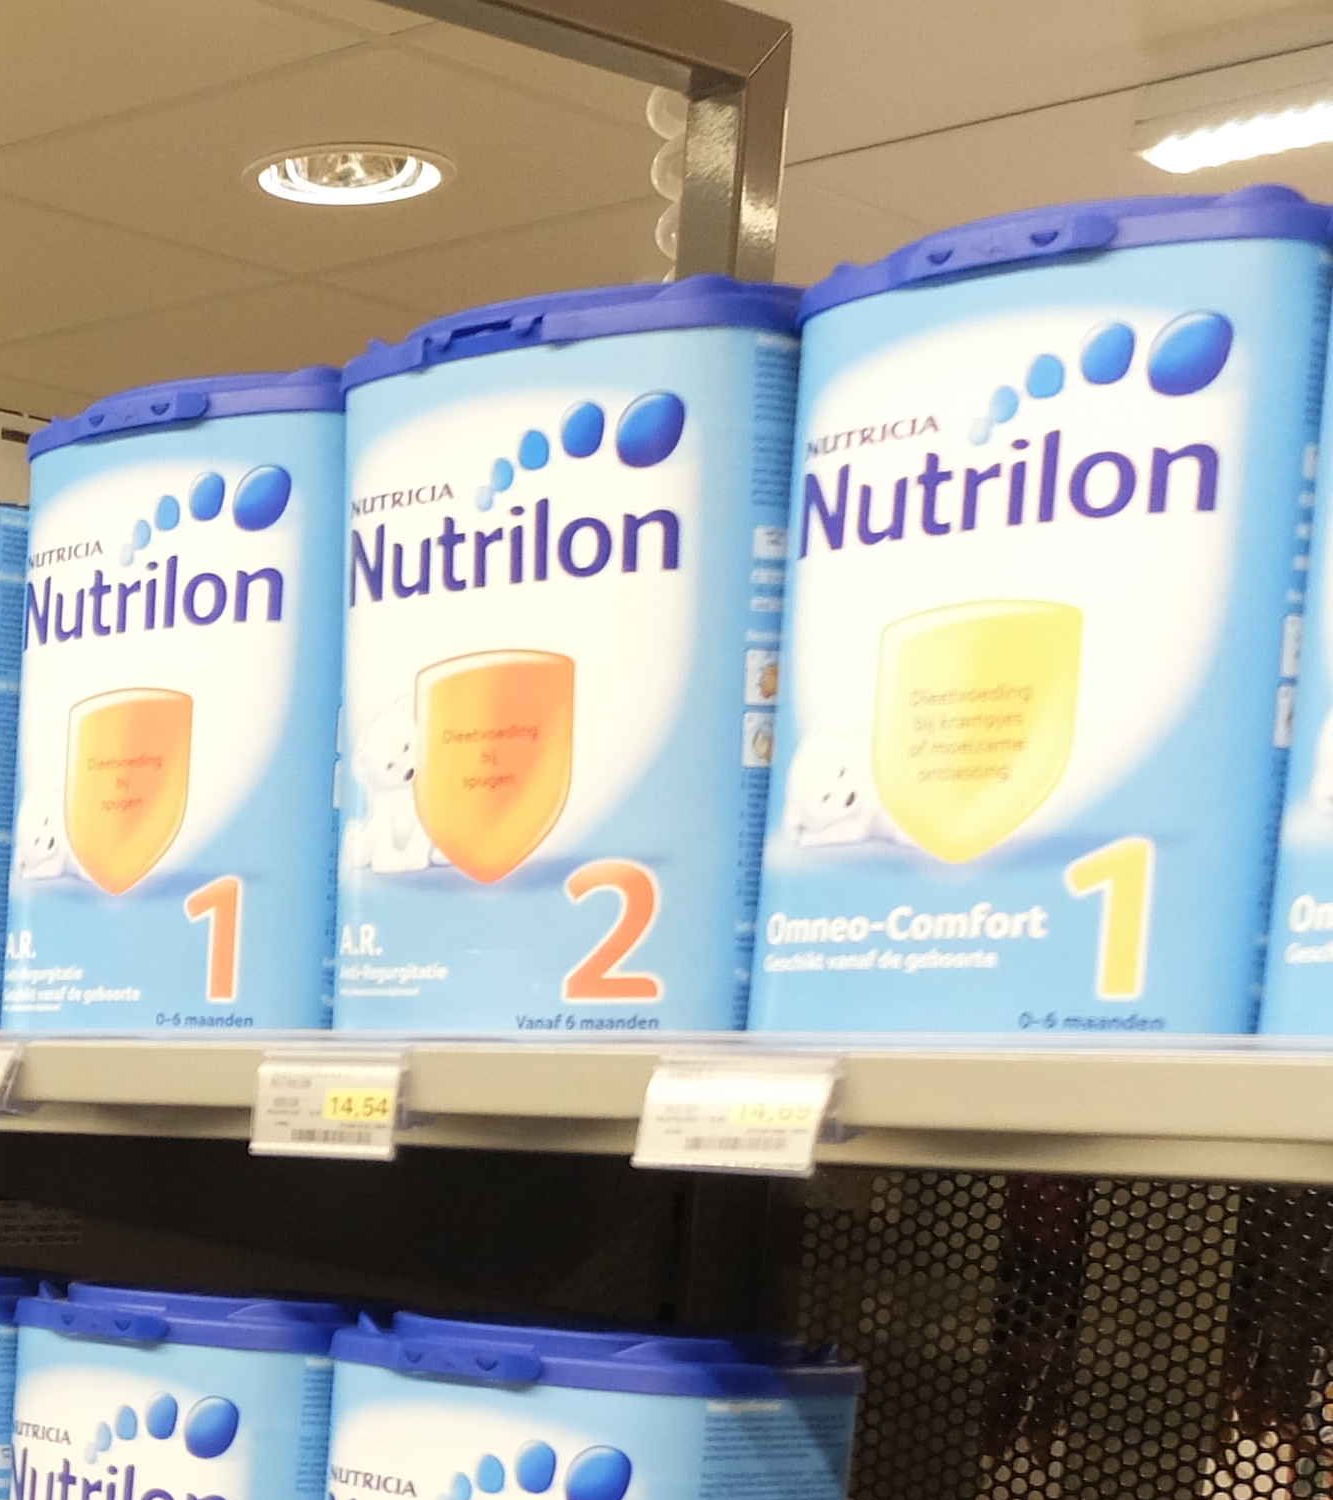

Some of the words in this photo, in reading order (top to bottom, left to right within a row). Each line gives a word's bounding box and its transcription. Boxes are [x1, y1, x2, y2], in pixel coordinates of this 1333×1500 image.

[798, 430, 1219, 559] Nutrilon
[349, 497, 680, 608] Nutrilon
[24, 555, 284, 649] Nutrilon
[184, 874, 243, 1004] 1
[340, 924, 383, 956] A.R.
[562, 858, 664, 1004] 2
[767, 903, 1048, 945] Omneo-Comfort
[1063, 836, 1155, 1001] 1
[184, 1013, 253, 1027] maanden
[515, 1014, 562, 1030] Vanaf
[565, 1014, 575, 1030] 6
[580, 1014, 660, 1030] maanden
[1063, 1013, 1165, 1031] maanden
[14, 1420, 71, 1446] UTRICIA
